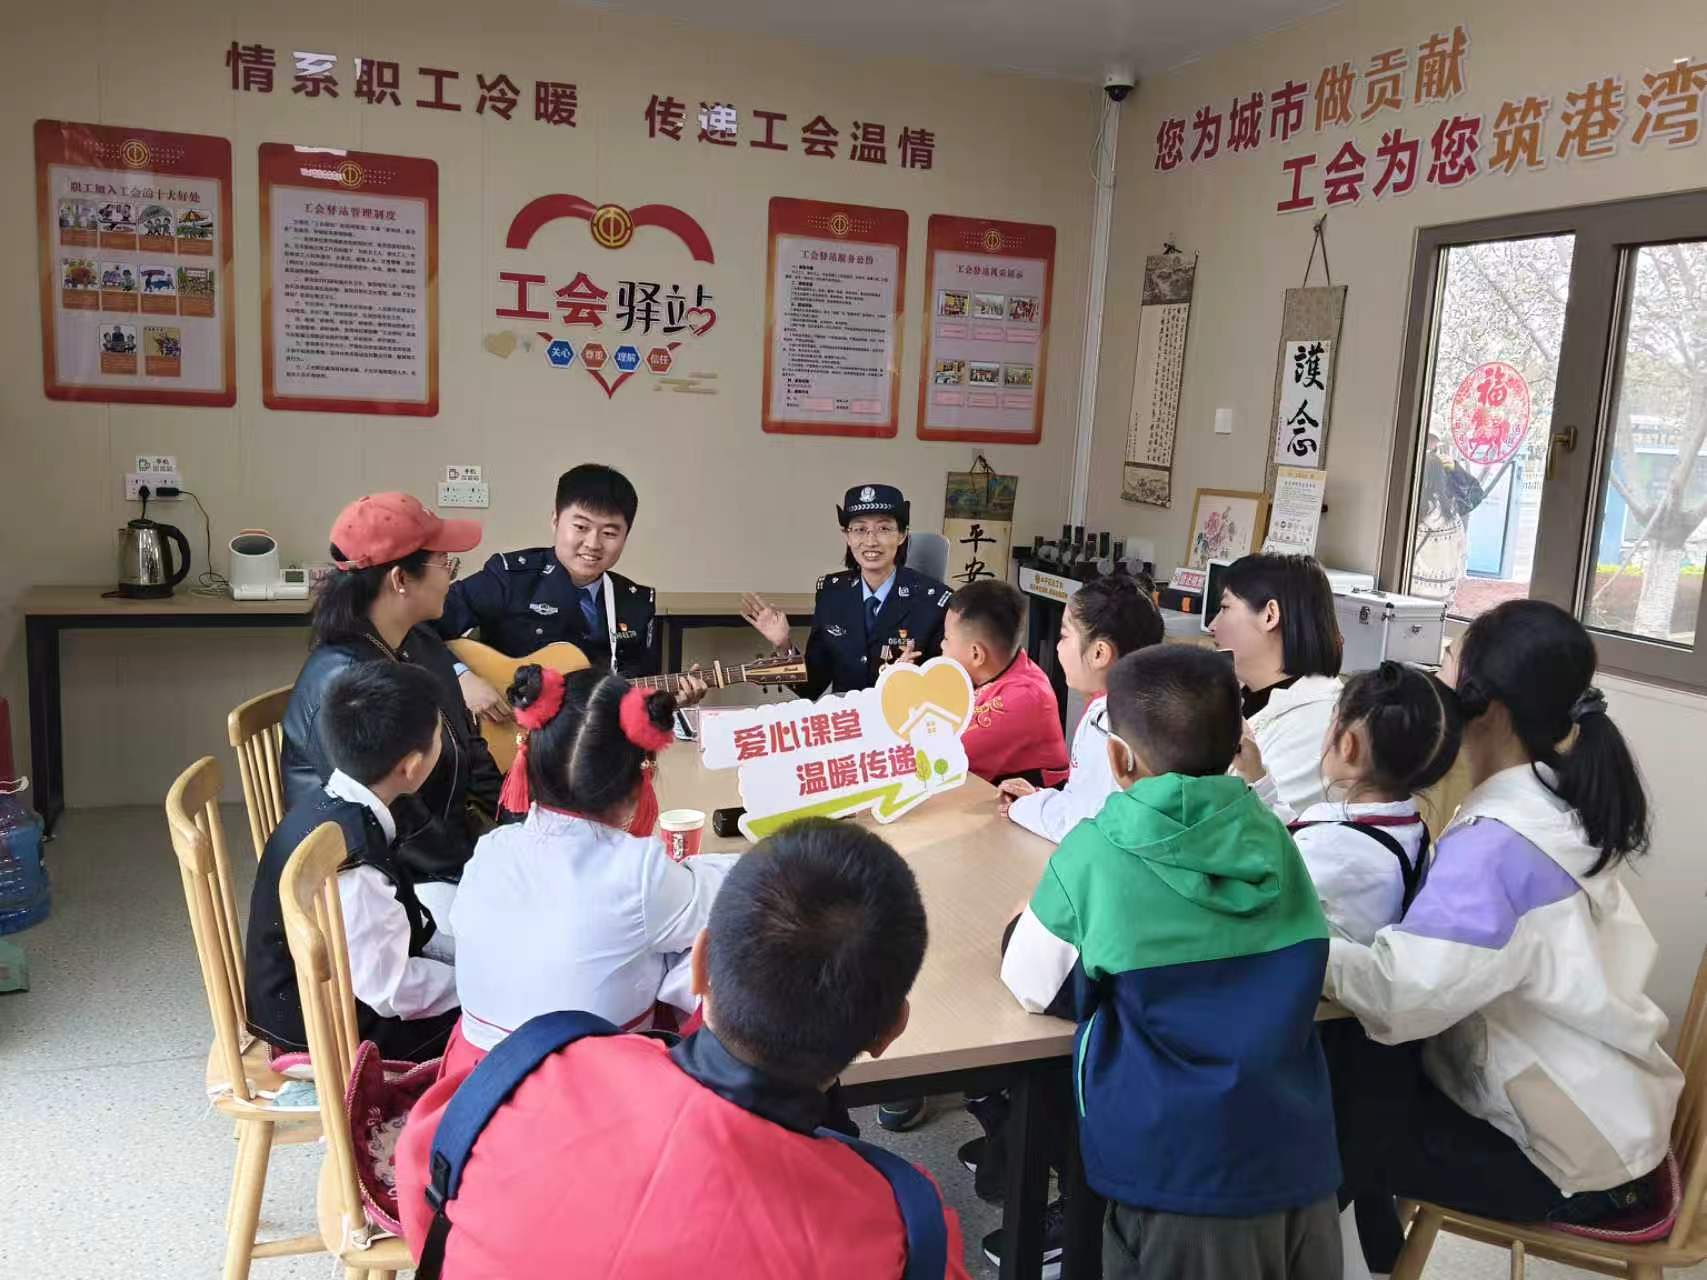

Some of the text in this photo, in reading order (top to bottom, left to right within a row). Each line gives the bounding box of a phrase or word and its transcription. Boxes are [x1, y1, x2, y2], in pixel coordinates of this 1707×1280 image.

[225, 41, 936, 170] 情系职工冷暖 传递工会温情
[1154, 25, 1468, 171] 您为城市做贡献
[1276, 58, 1707, 213] 工会为您筑港湾
[496, 271, 717, 337] 工会驿站
[551, 345, 572, 359] 关心
[617, 351, 637, 363] 理解
[650, 354, 669, 365] 信任
[1477, 366, 1508, 407] 福
[734, 708, 863, 761] 爱心课堂
[796, 743, 919, 796] 温暖传递
